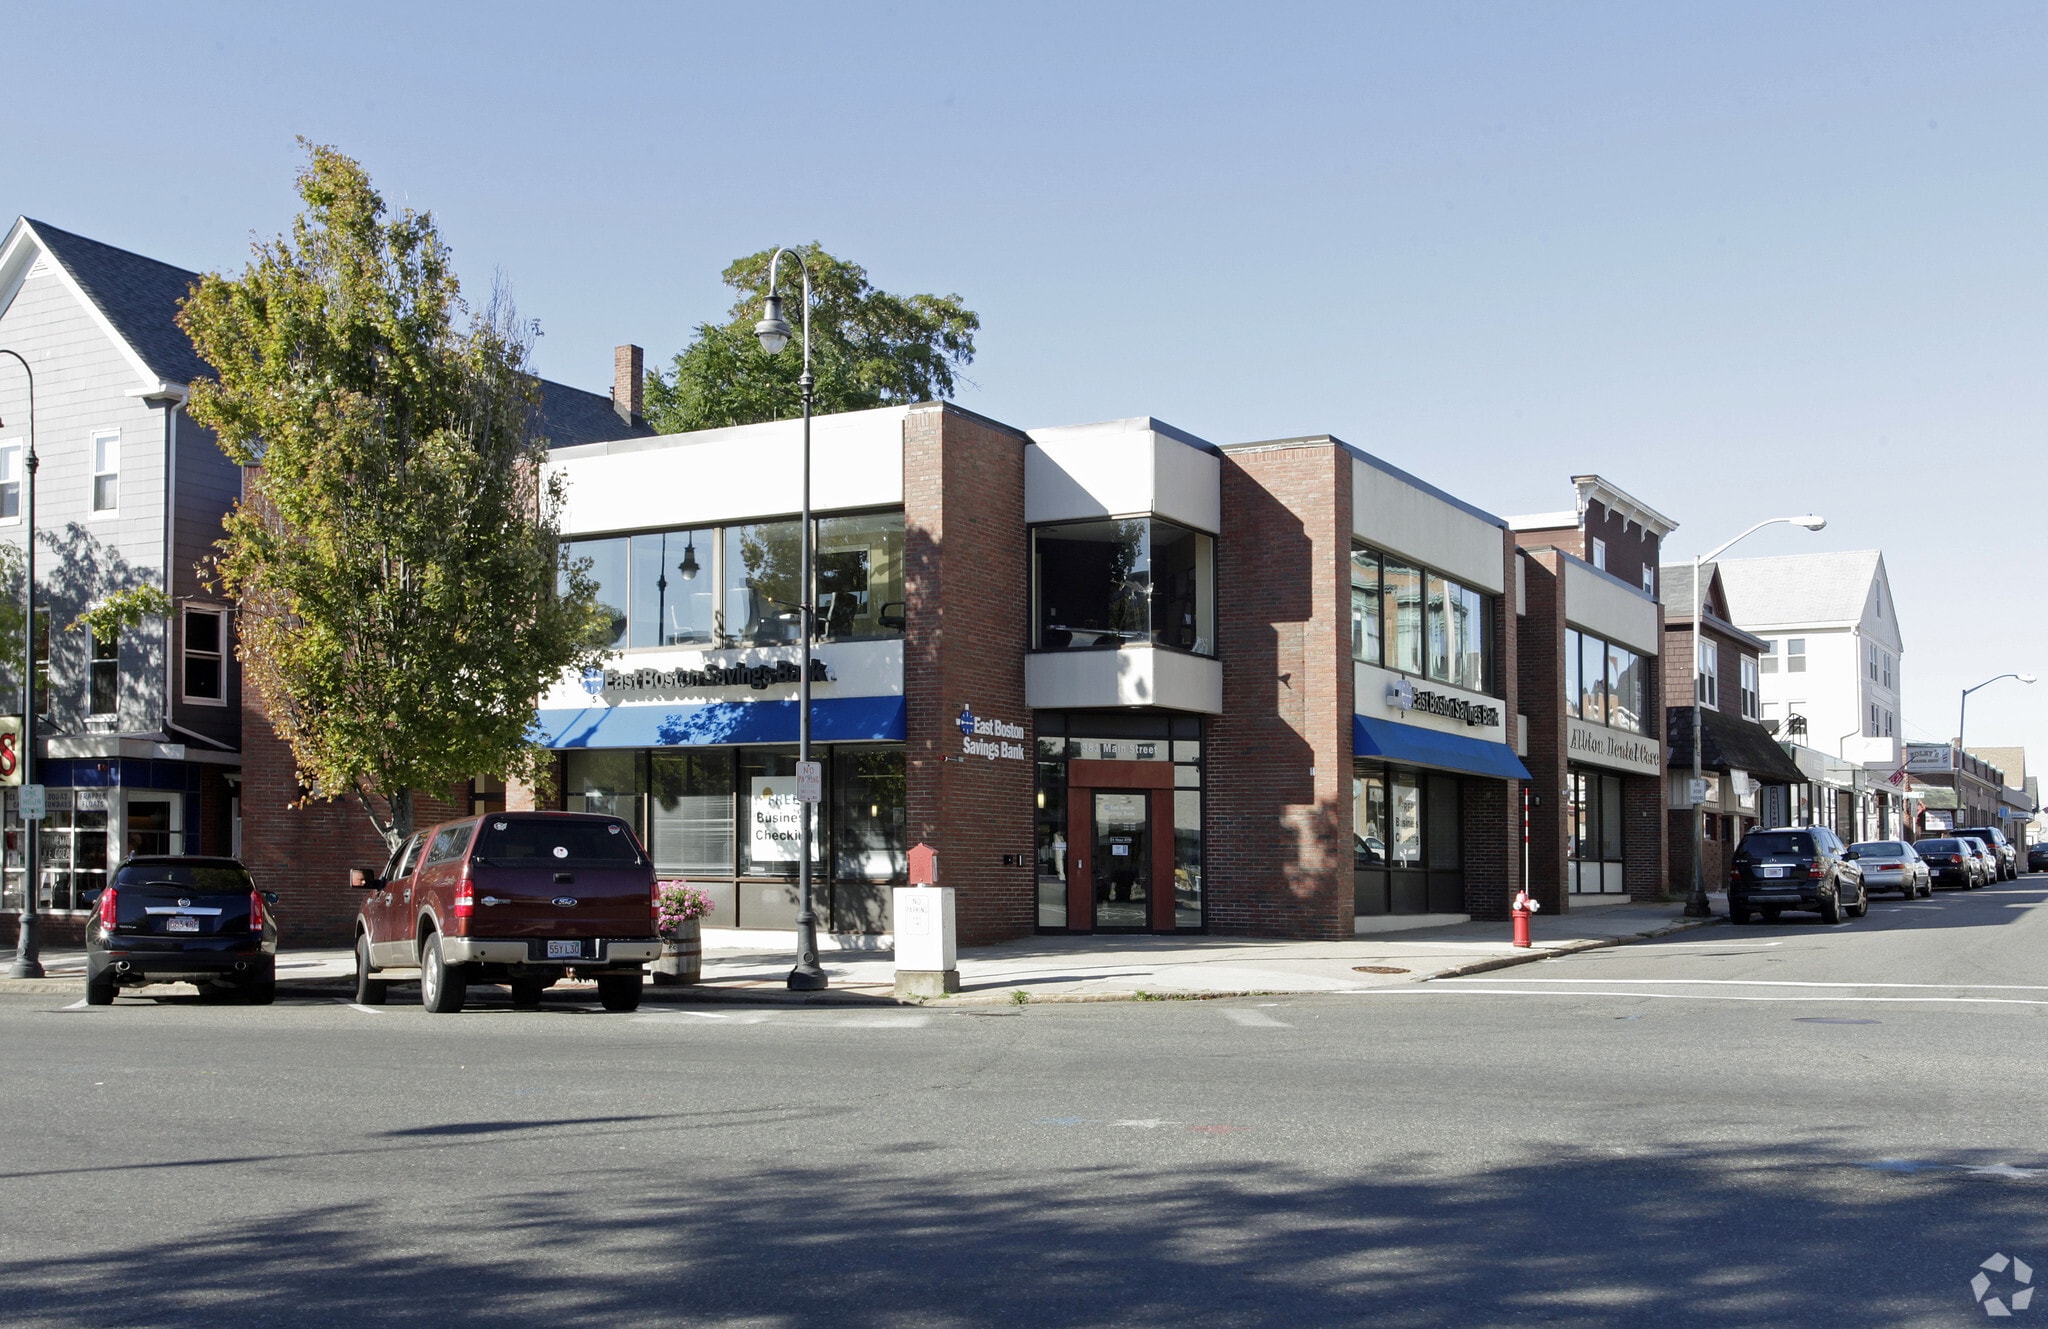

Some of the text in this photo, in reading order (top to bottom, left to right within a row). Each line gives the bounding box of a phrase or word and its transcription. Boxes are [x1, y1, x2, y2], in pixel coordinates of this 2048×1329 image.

[603, 659, 828, 690] East Boston Savings Bak
[1412, 687, 1499, 727] East Boston Savings Bank
[974, 716, 1024, 740] East Boston
[963, 736, 1024, 760] Savings Bank
[1103, 743, 1126, 753] Main
[1129, 744, 1157, 754] Street
[1570, 728, 1660, 766] Albion Dental Care
[803, 767, 814, 775] NO
[757, 811, 802, 823] Busine
[756, 830, 812, 841] Checki
[54, 848, 72, 859] CREA
